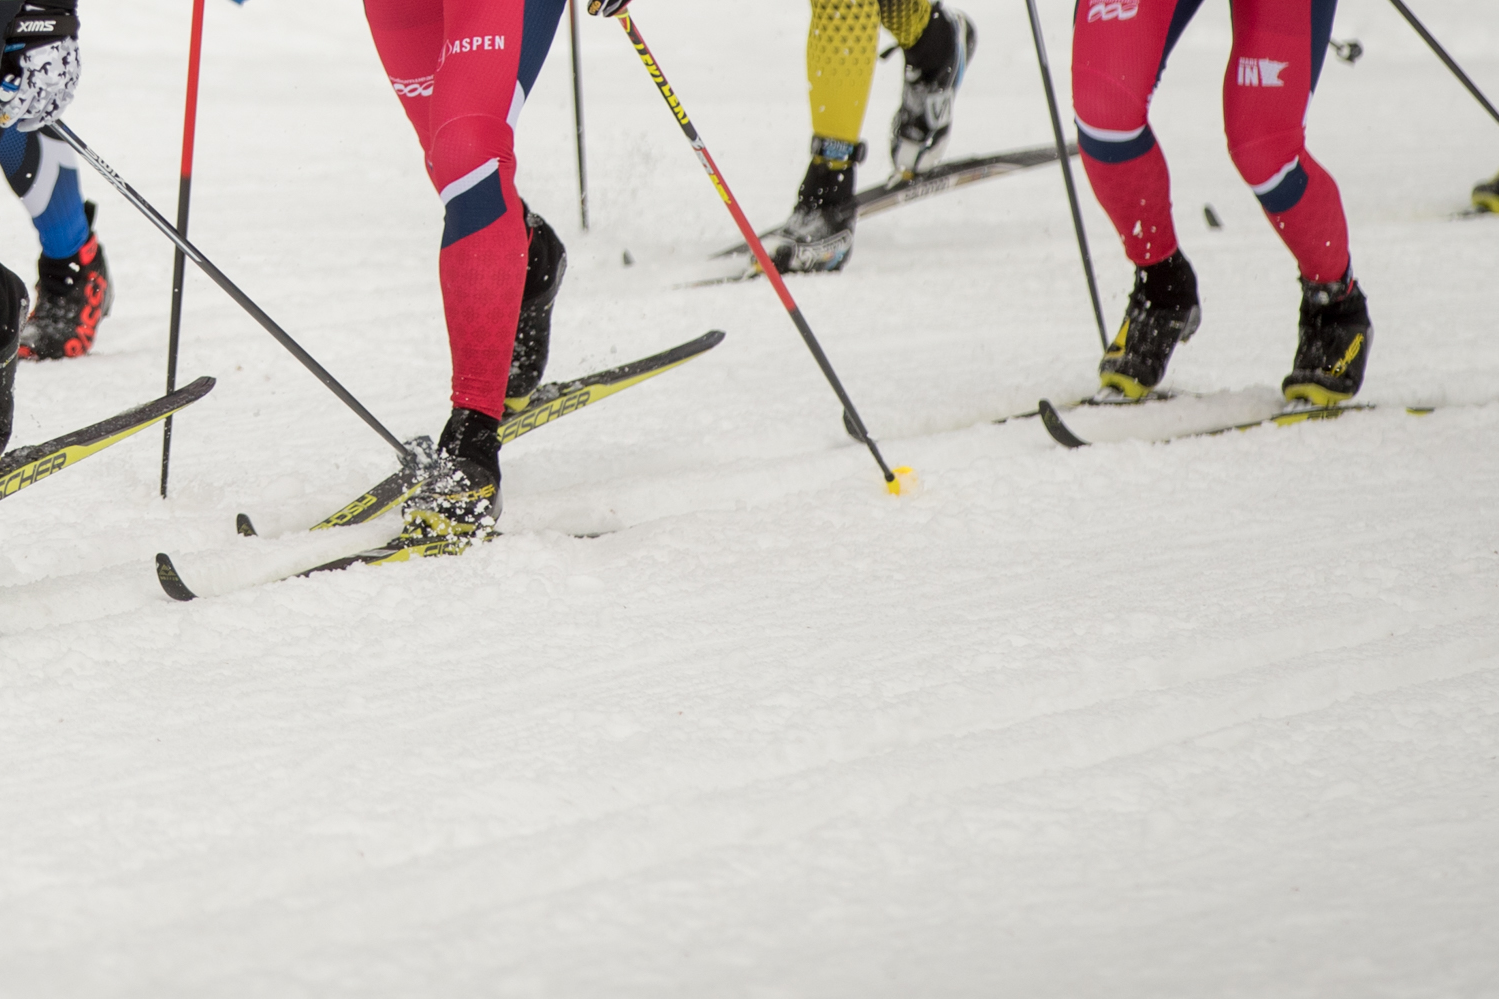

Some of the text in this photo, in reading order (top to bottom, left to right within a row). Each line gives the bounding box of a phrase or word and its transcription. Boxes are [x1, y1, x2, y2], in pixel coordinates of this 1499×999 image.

[17, 20, 56, 33] SWIX
[452, 36, 504, 54] ASPEN
[500, 391, 591, 444] FISCHER
